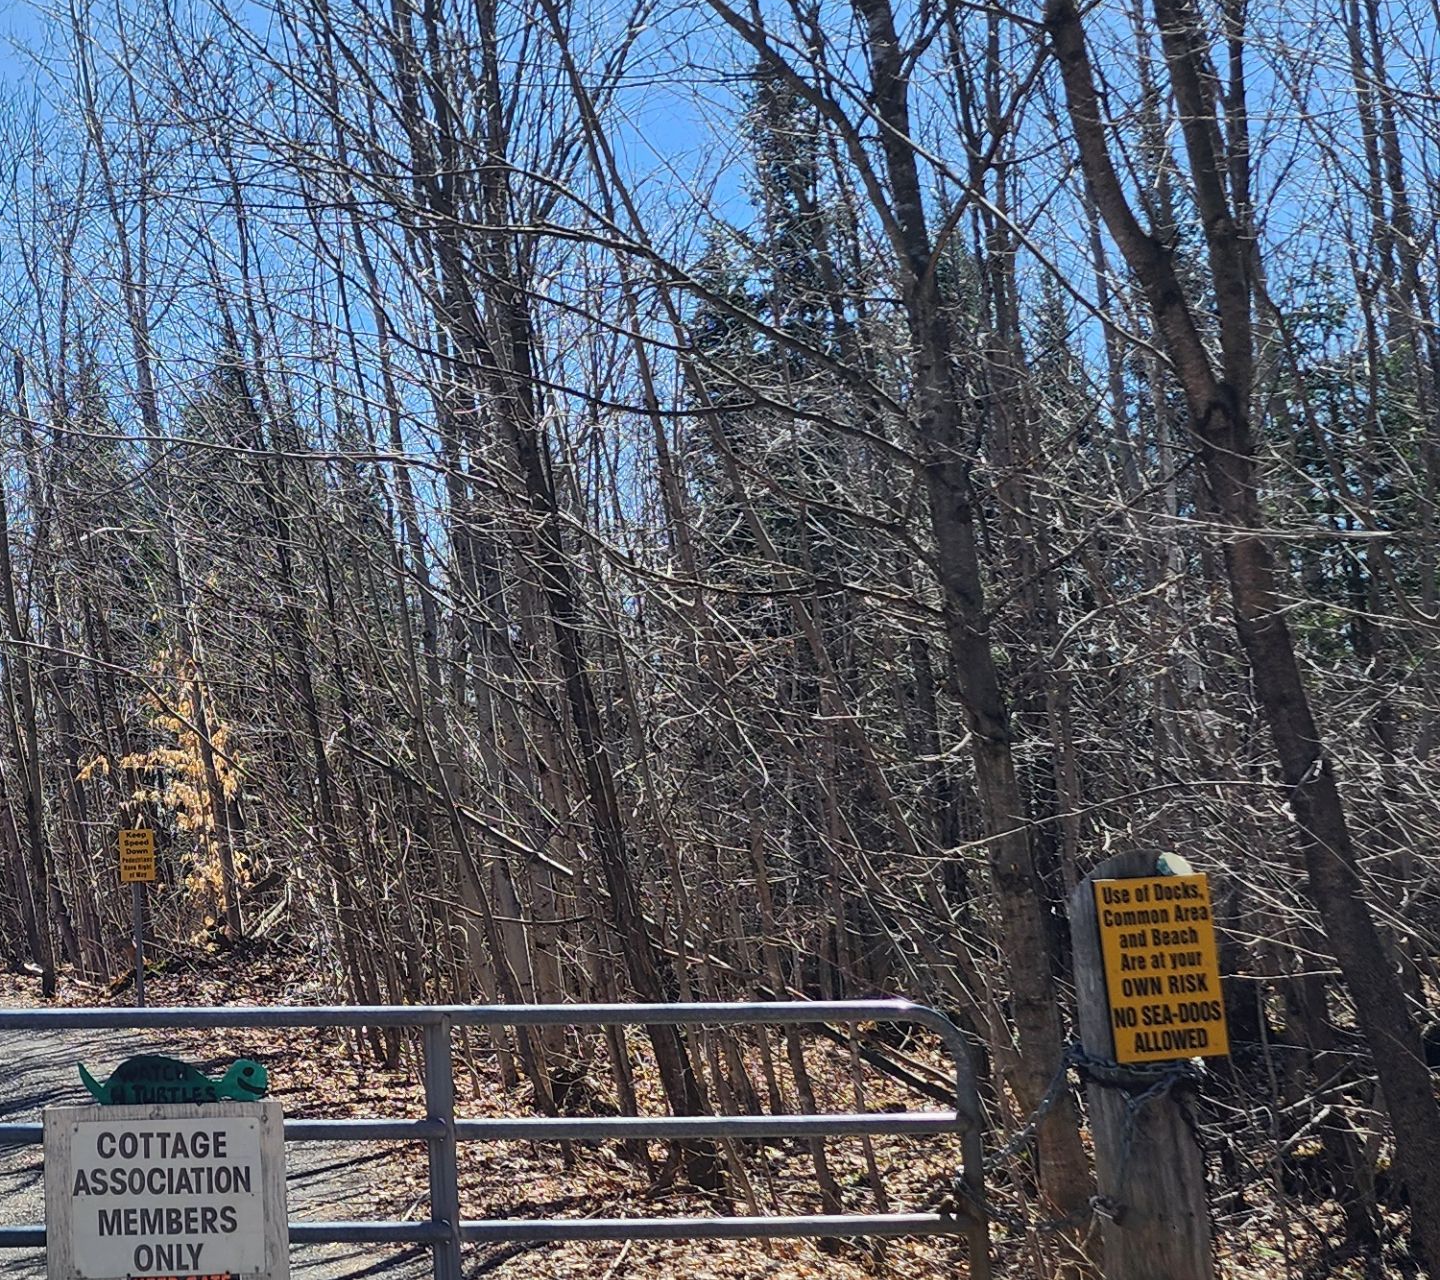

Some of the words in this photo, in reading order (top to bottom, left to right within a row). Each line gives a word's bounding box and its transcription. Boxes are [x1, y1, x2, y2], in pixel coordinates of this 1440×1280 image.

[1102, 887, 1130, 904] Use
[1135, 885, 1150, 901] of
[1153, 882, 1204, 901] Docks,
[1103, 907, 1169, 927] Common
[1174, 904, 1208, 922] Area
[1119, 929, 1147, 949] and
[1152, 926, 1198, 946] Beach
[1121, 953, 1146, 971] Are
[1151, 952, 1167, 969] at
[1170, 951, 1202, 970] your
[1122, 975, 1162, 997] OWN
[1169, 973, 1208, 994] RISK
[1113, 1006, 1137, 1028] NO
[1142, 1000, 1221, 1026] SEA-DOOS
[1134, 1028, 1208, 1053] ALLOWED
[119, 1063, 190, 1082] WATCH
[132, 1084, 218, 1104] TURTLES
[97, 1131, 227, 1159] COTTAGE
[73, 1166, 251, 1196] ASSOCIATION
[98, 1206, 238, 1236] MEMBERS
[133, 1243, 204, 1271] ONLY
